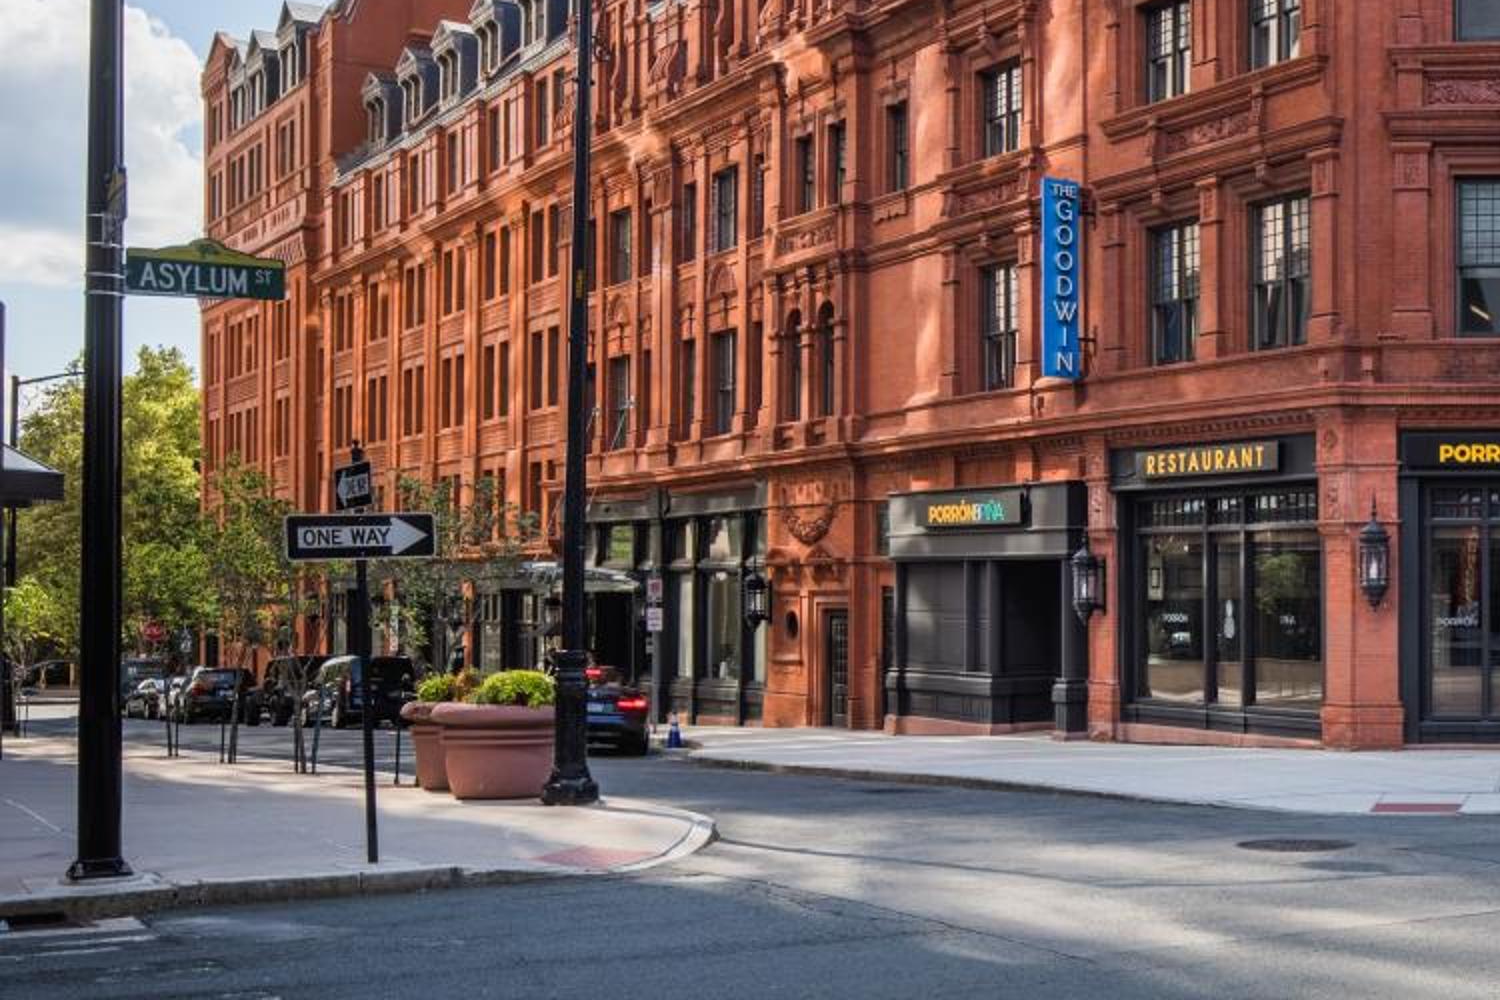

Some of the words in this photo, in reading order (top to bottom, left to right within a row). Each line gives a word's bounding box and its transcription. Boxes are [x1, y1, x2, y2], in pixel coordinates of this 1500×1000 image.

[1053, 183, 1077, 198] THE
[140, 261, 248, 294] ASYLUM
[255, 270, 273, 285] ST
[1053, 201, 1077, 372] GOODWIN
[1146, 445, 1265, 475] RESTAURANT
[303, 529, 343, 545] ONE
[351, 528, 391, 545] WAY
